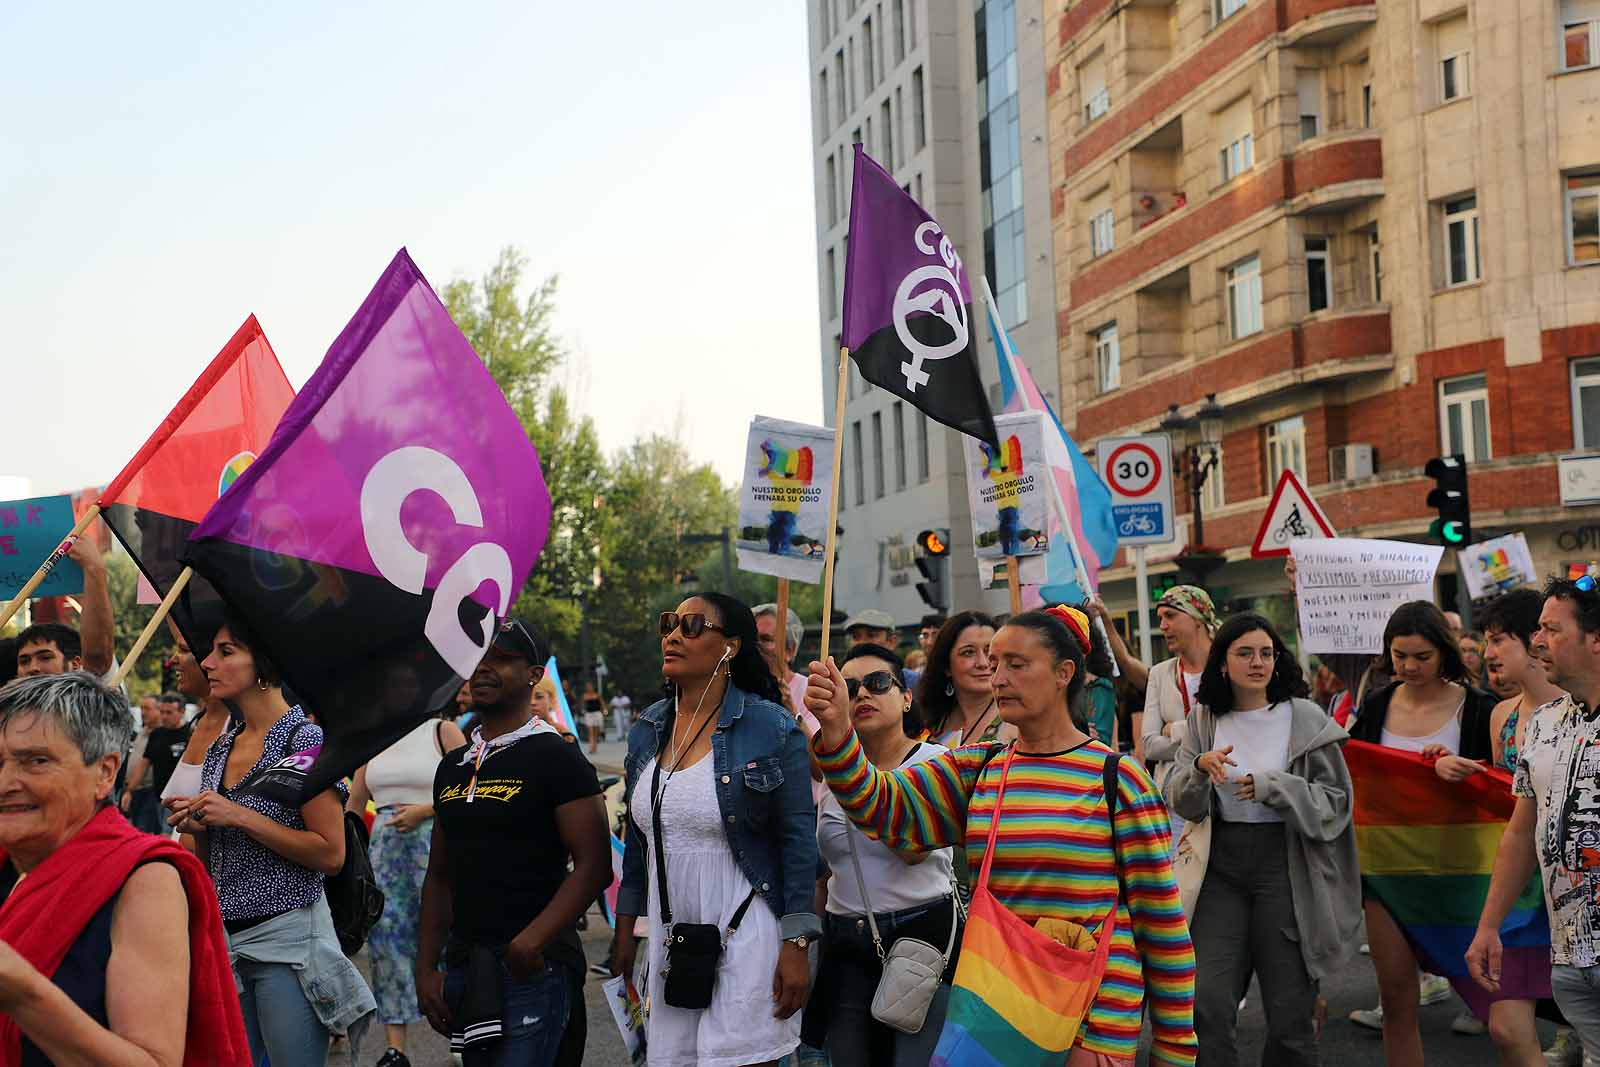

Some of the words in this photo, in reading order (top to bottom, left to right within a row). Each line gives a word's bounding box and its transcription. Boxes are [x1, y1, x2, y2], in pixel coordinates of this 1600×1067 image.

[1118, 461, 1149, 479] 30
[752, 486, 784, 495] NUESTRO
[786, 487, 822, 496] ORGULLO
[980, 484, 1004, 497] NUESTRO
[1004, 475, 1034, 489] ORGULLO
[1007, 488, 1016, 497] SU
[1016, 484, 1034, 495] ODIO
[787, 495, 798, 503] SU
[799, 495, 820, 503] ODIO
[1360, 552, 1374, 563] NO
